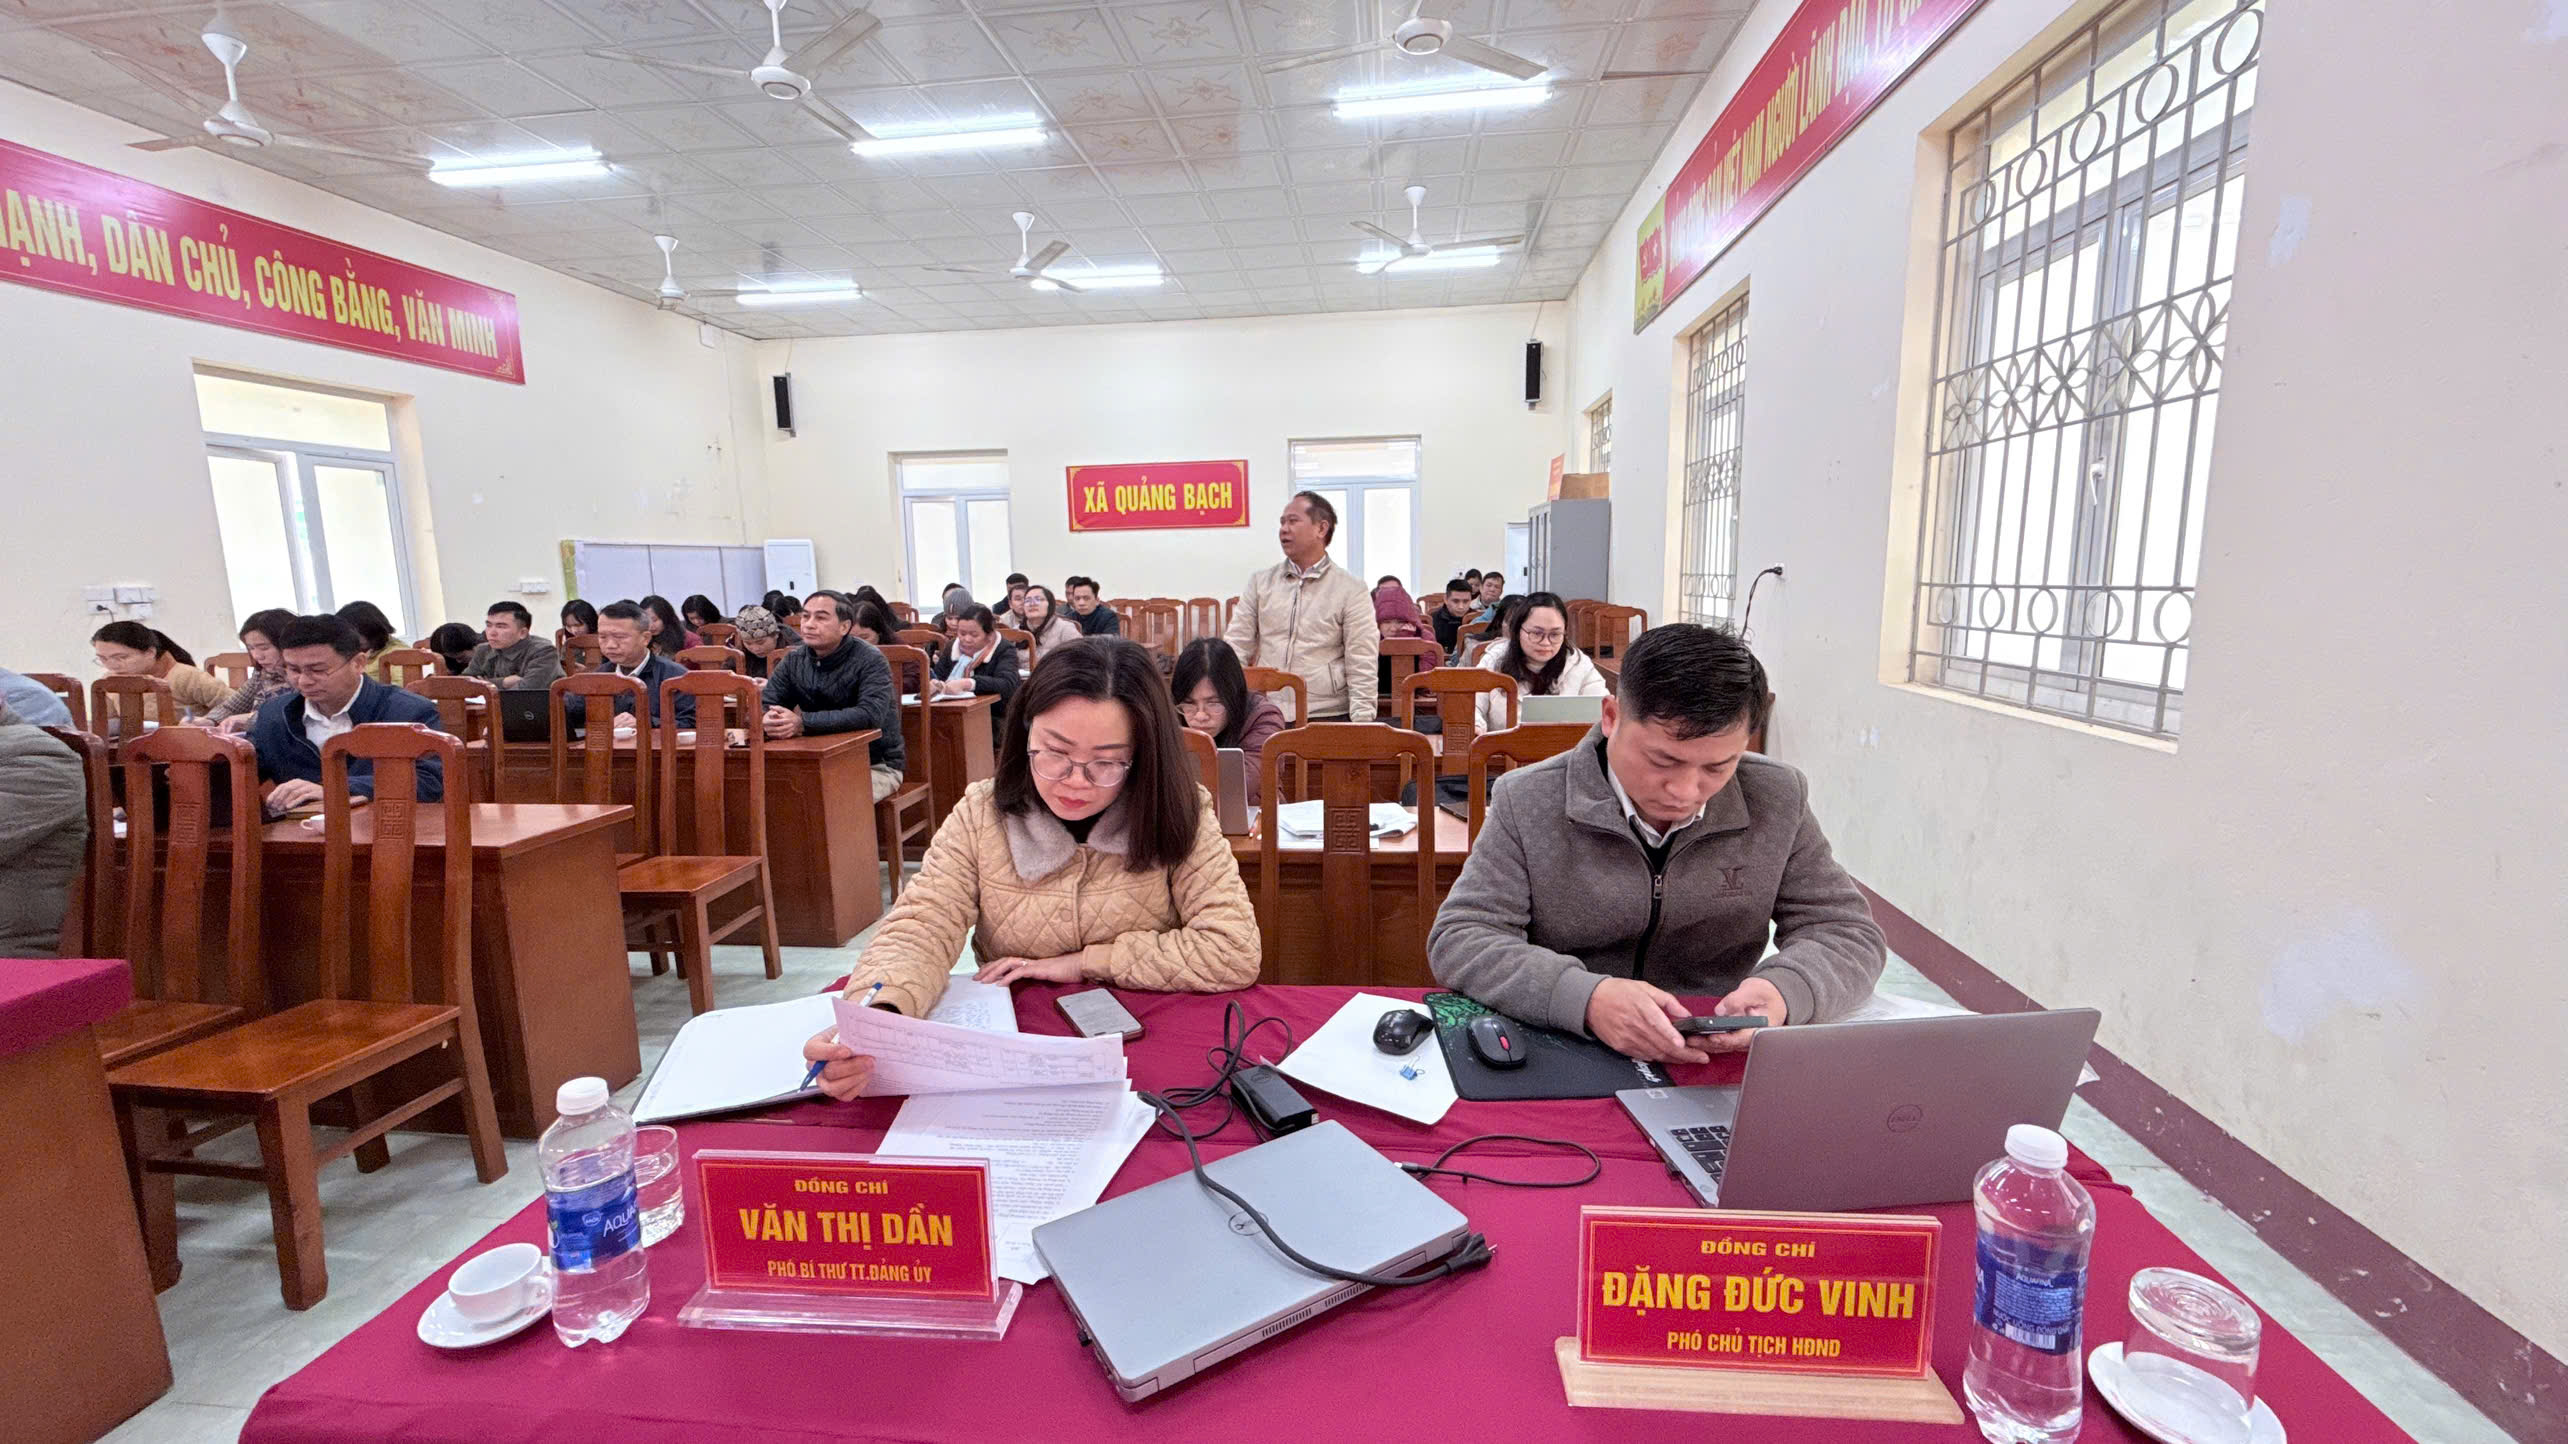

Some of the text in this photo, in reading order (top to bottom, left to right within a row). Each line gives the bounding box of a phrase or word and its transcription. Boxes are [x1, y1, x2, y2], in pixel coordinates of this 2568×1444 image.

[1722, 129, 1742, 216] VIỆT
[1741, 108, 1765, 198] NAM
[1764, 52, 1800, 174] NGƯỜI
[1799, 20, 1836, 136] LÃNH
[0, 188, 499, 359] ẠNH, DÂN CHỦ, CÔNG BẰNG, VĂN MINH
[1084, 475, 1233, 516] XÃ QUẢNG BẠCH
[855, 1180, 889, 1195] CHÍ
[738, 1202, 954, 1250] VĂN THỊ DẦN
[767, 1257, 932, 1283] PHÓ BÍ THƯ TT.ĐẢNG ỦY
[1775, 1241, 1817, 1258] CHÍ
[1602, 1265, 1711, 1316] ĐẶNG
[1723, 1266, 1805, 1315] ĐỨC
[1818, 1279, 1916, 1320] VINH
[1666, 1327, 1841, 1358] PHÓ CHỦ TỊCH HĐND
